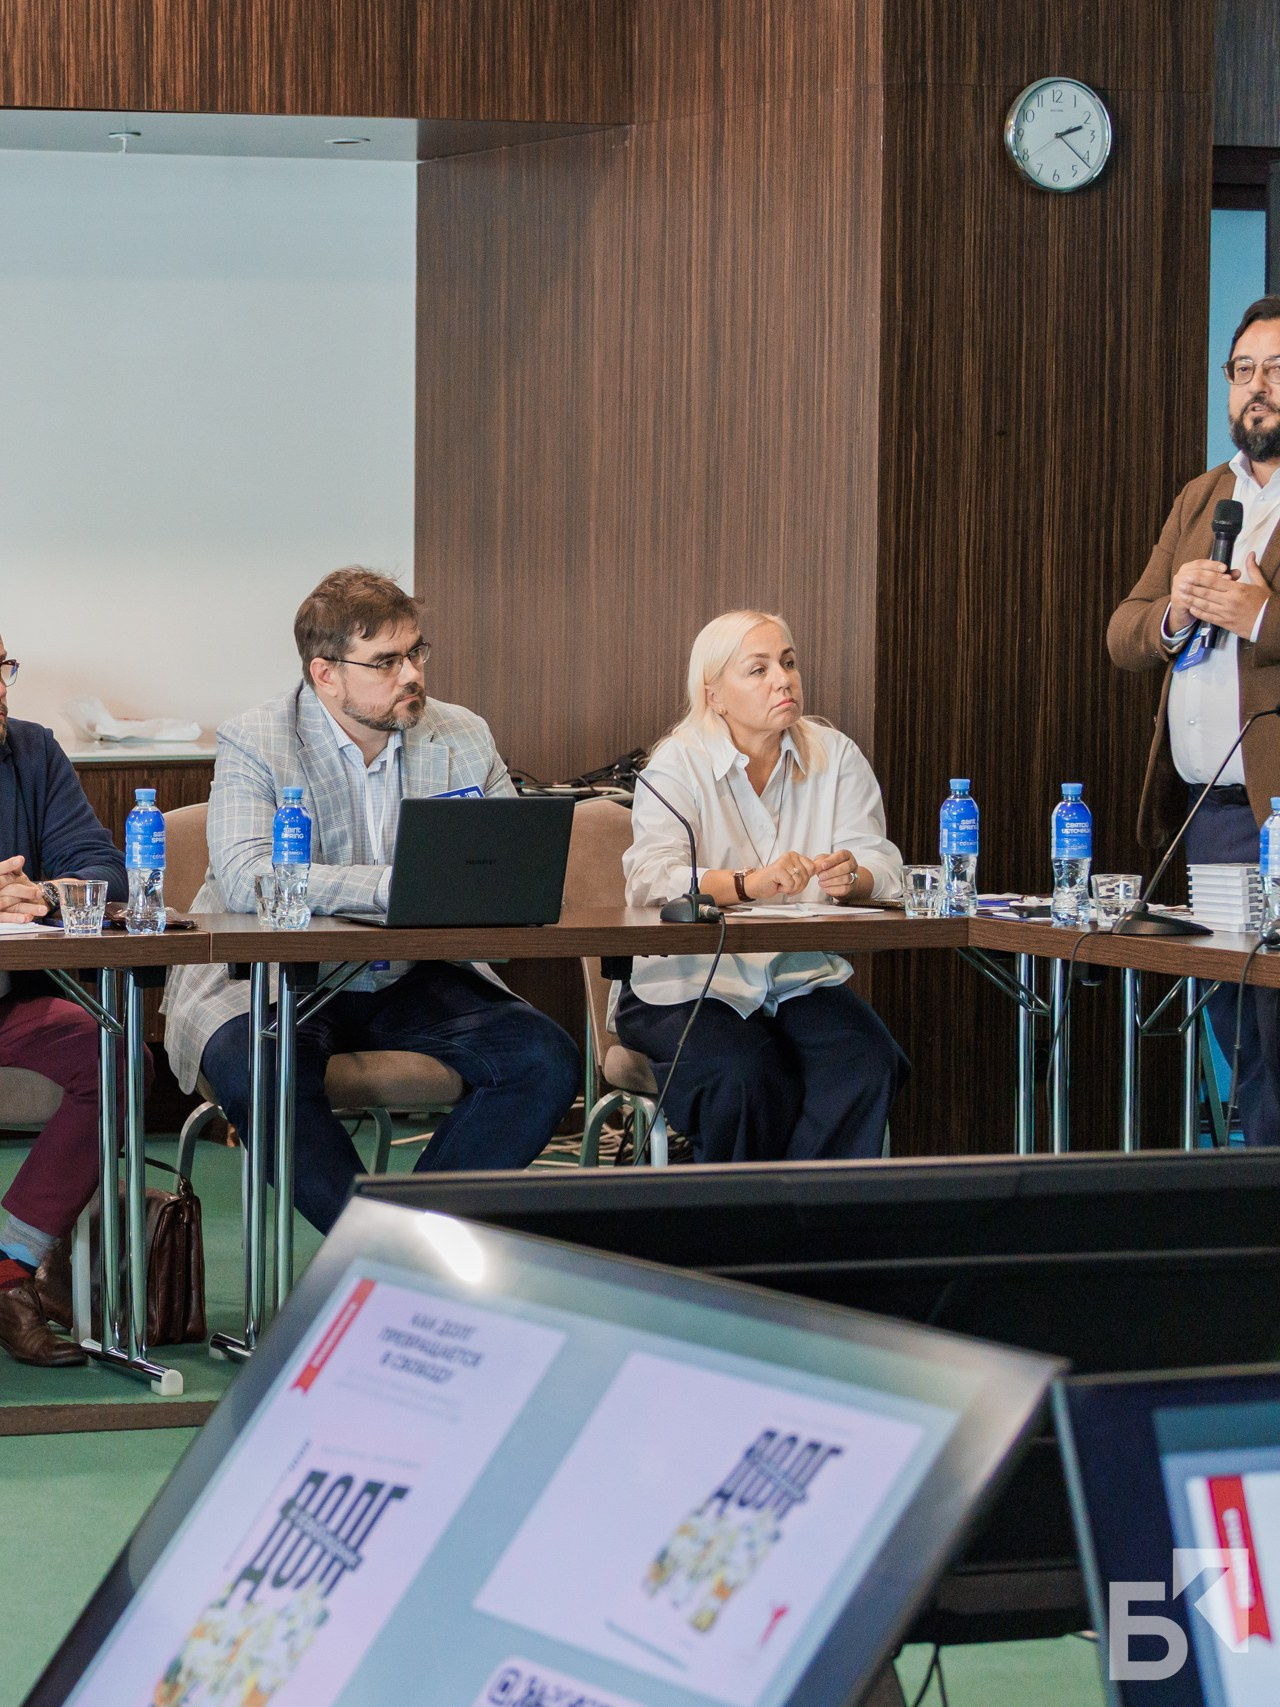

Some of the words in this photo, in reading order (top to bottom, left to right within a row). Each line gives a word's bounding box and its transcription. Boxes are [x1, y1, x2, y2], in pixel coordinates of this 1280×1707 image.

[1037, 94, 1043, 108] 11
[1052, 89, 1063, 103] 12
[1022, 109, 1035, 123] 10
[1083, 110, 1091, 125] 2
[1017, 128, 1025, 142] 9
[1090, 130, 1096, 143] 3
[1022, 148, 1030, 161] 8
[1083, 150, 1090, 163] 4
[1036, 163, 1043, 177] 7
[1052, 169, 1060, 183] 6
[1072, 164, 1078, 178] 5
[696, 1429, 845, 1520] ДОЛГ
[216, 1470, 411, 1609] ДОЛГ
